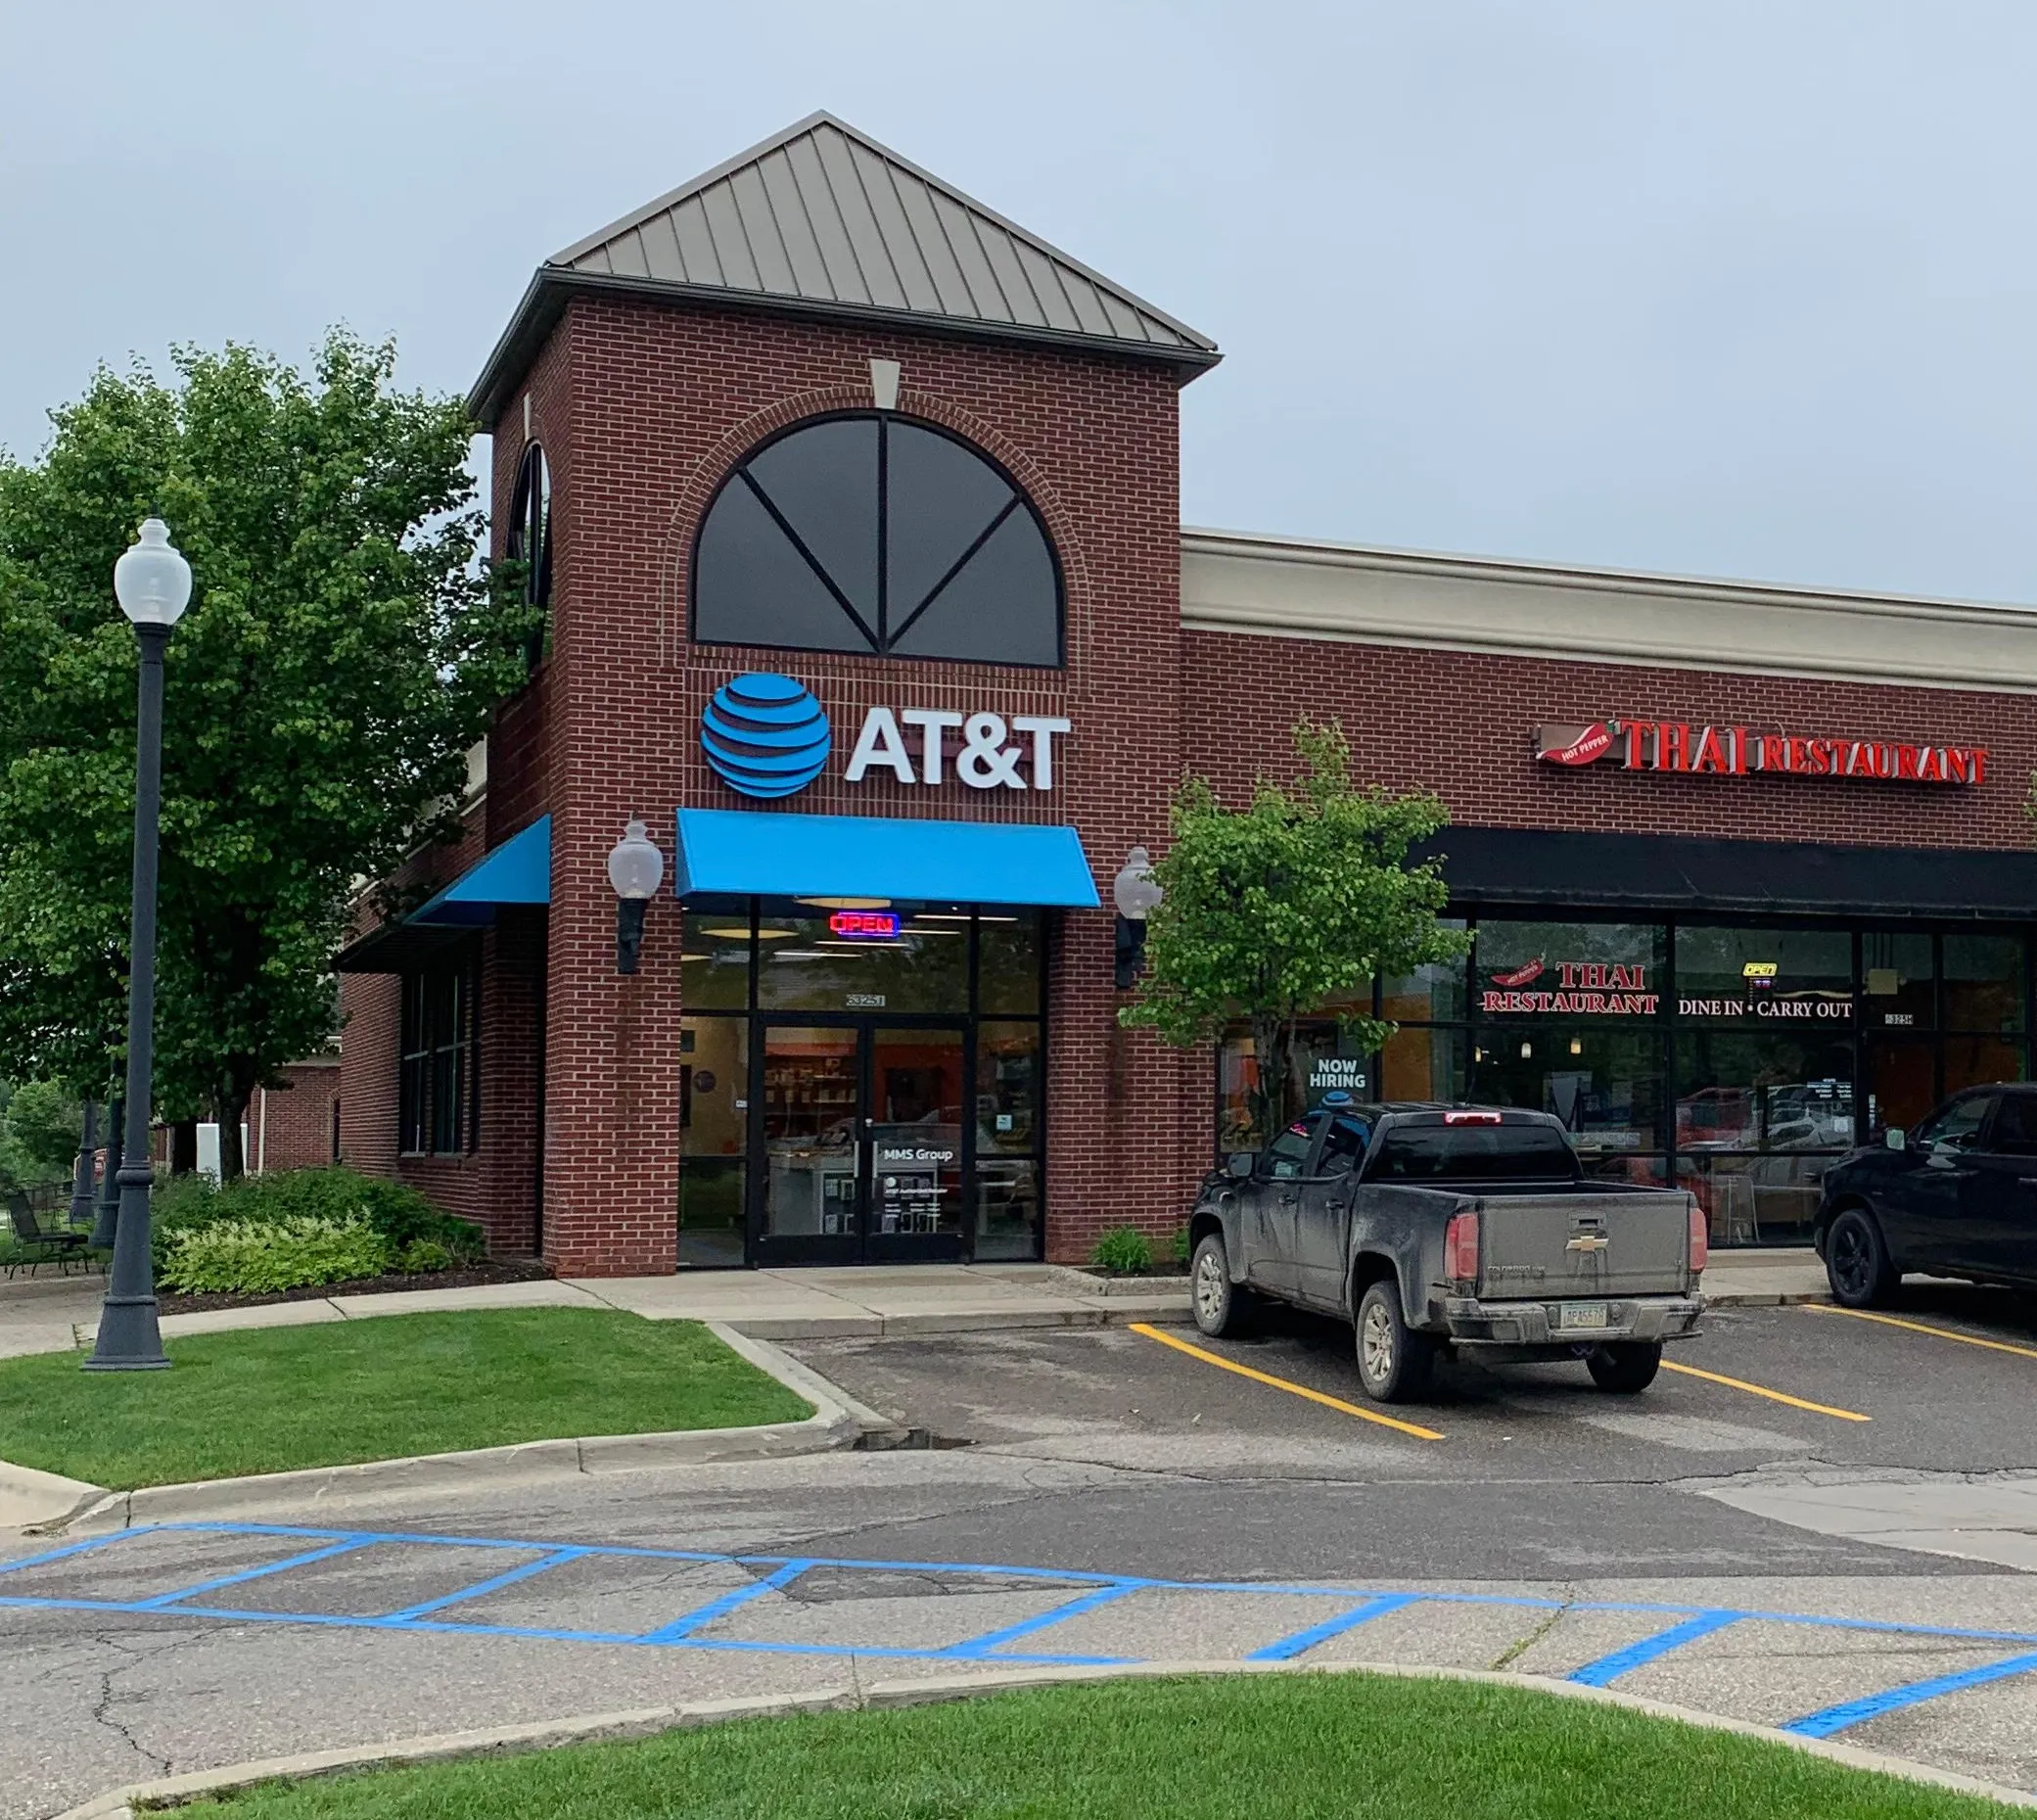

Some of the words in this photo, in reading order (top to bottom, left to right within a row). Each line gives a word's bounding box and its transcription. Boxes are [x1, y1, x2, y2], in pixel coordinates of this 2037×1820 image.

[845, 707, 1071, 790] AT&T
[1561, 747, 1579, 762] HOT
[1579, 734, 1609, 754] PEPPER
[1618, 719, 1750, 774] THAI
[1756, 735, 1989, 784] RESTAURANT
[829, 914, 895, 934] OPEN
[1555, 961, 1644, 990] THAI
[1745, 964, 1775, 975] OPEN
[1483, 992, 1659, 1014] RESTAURANT
[1679, 1000, 1721, 1015] DINE
[1724, 1001, 1743, 1015] IN
[1757, 1002, 1813, 1017] CARRY
[1817, 1003, 1852, 1017] OUT
[1319, 1059, 1357, 1073] NOW
[1310, 1073, 1366, 1088] HIRING
[884, 1149, 913, 1159] MMS
[916, 1148, 953, 1162] Group
